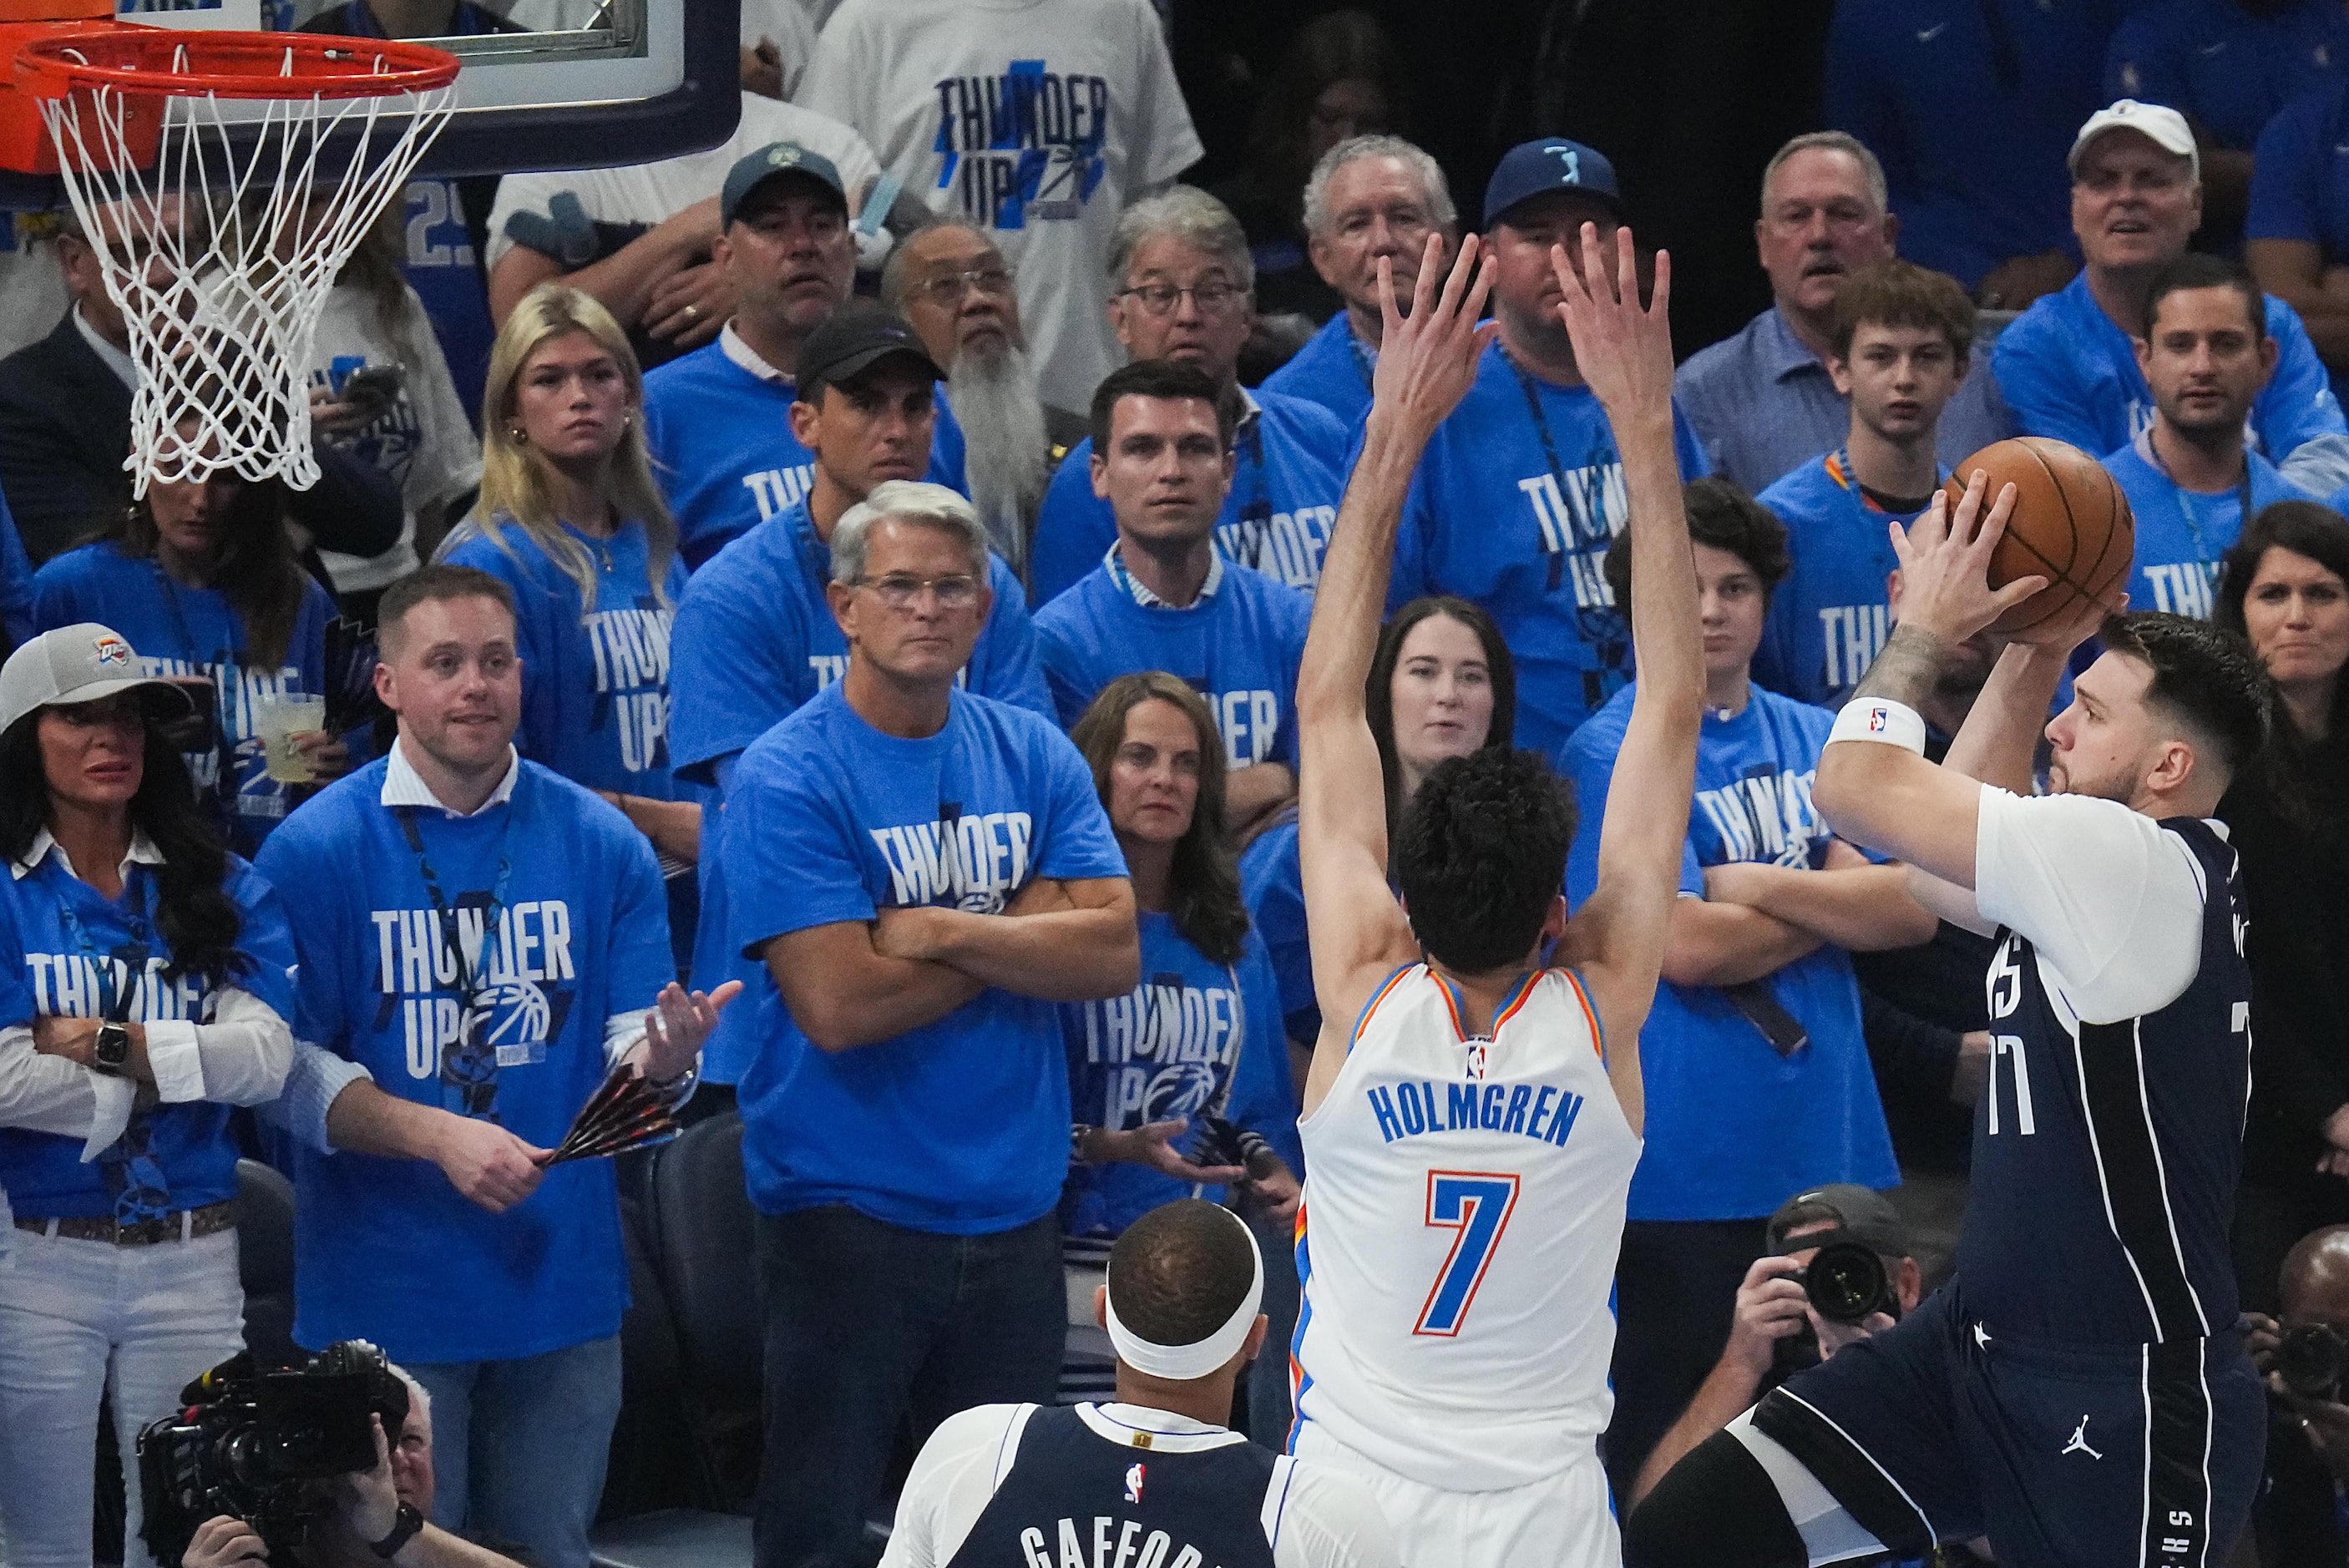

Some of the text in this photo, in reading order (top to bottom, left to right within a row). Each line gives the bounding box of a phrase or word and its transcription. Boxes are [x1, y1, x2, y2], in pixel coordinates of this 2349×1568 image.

[934, 73, 1107, 151] THUNDER
[961, 156, 1020, 226] UP
[616, 692, 665, 772] UP
[869, 812, 1031, 904] THUNDER
[371, 900, 575, 994] THUNDER
[403, 998, 459, 1080] UP
[1367, 1081, 1584, 1148] HOLMGREN
[1412, 1169, 1520, 1337] 7
[1020, 1515, 1221, 1568] GAFFO
